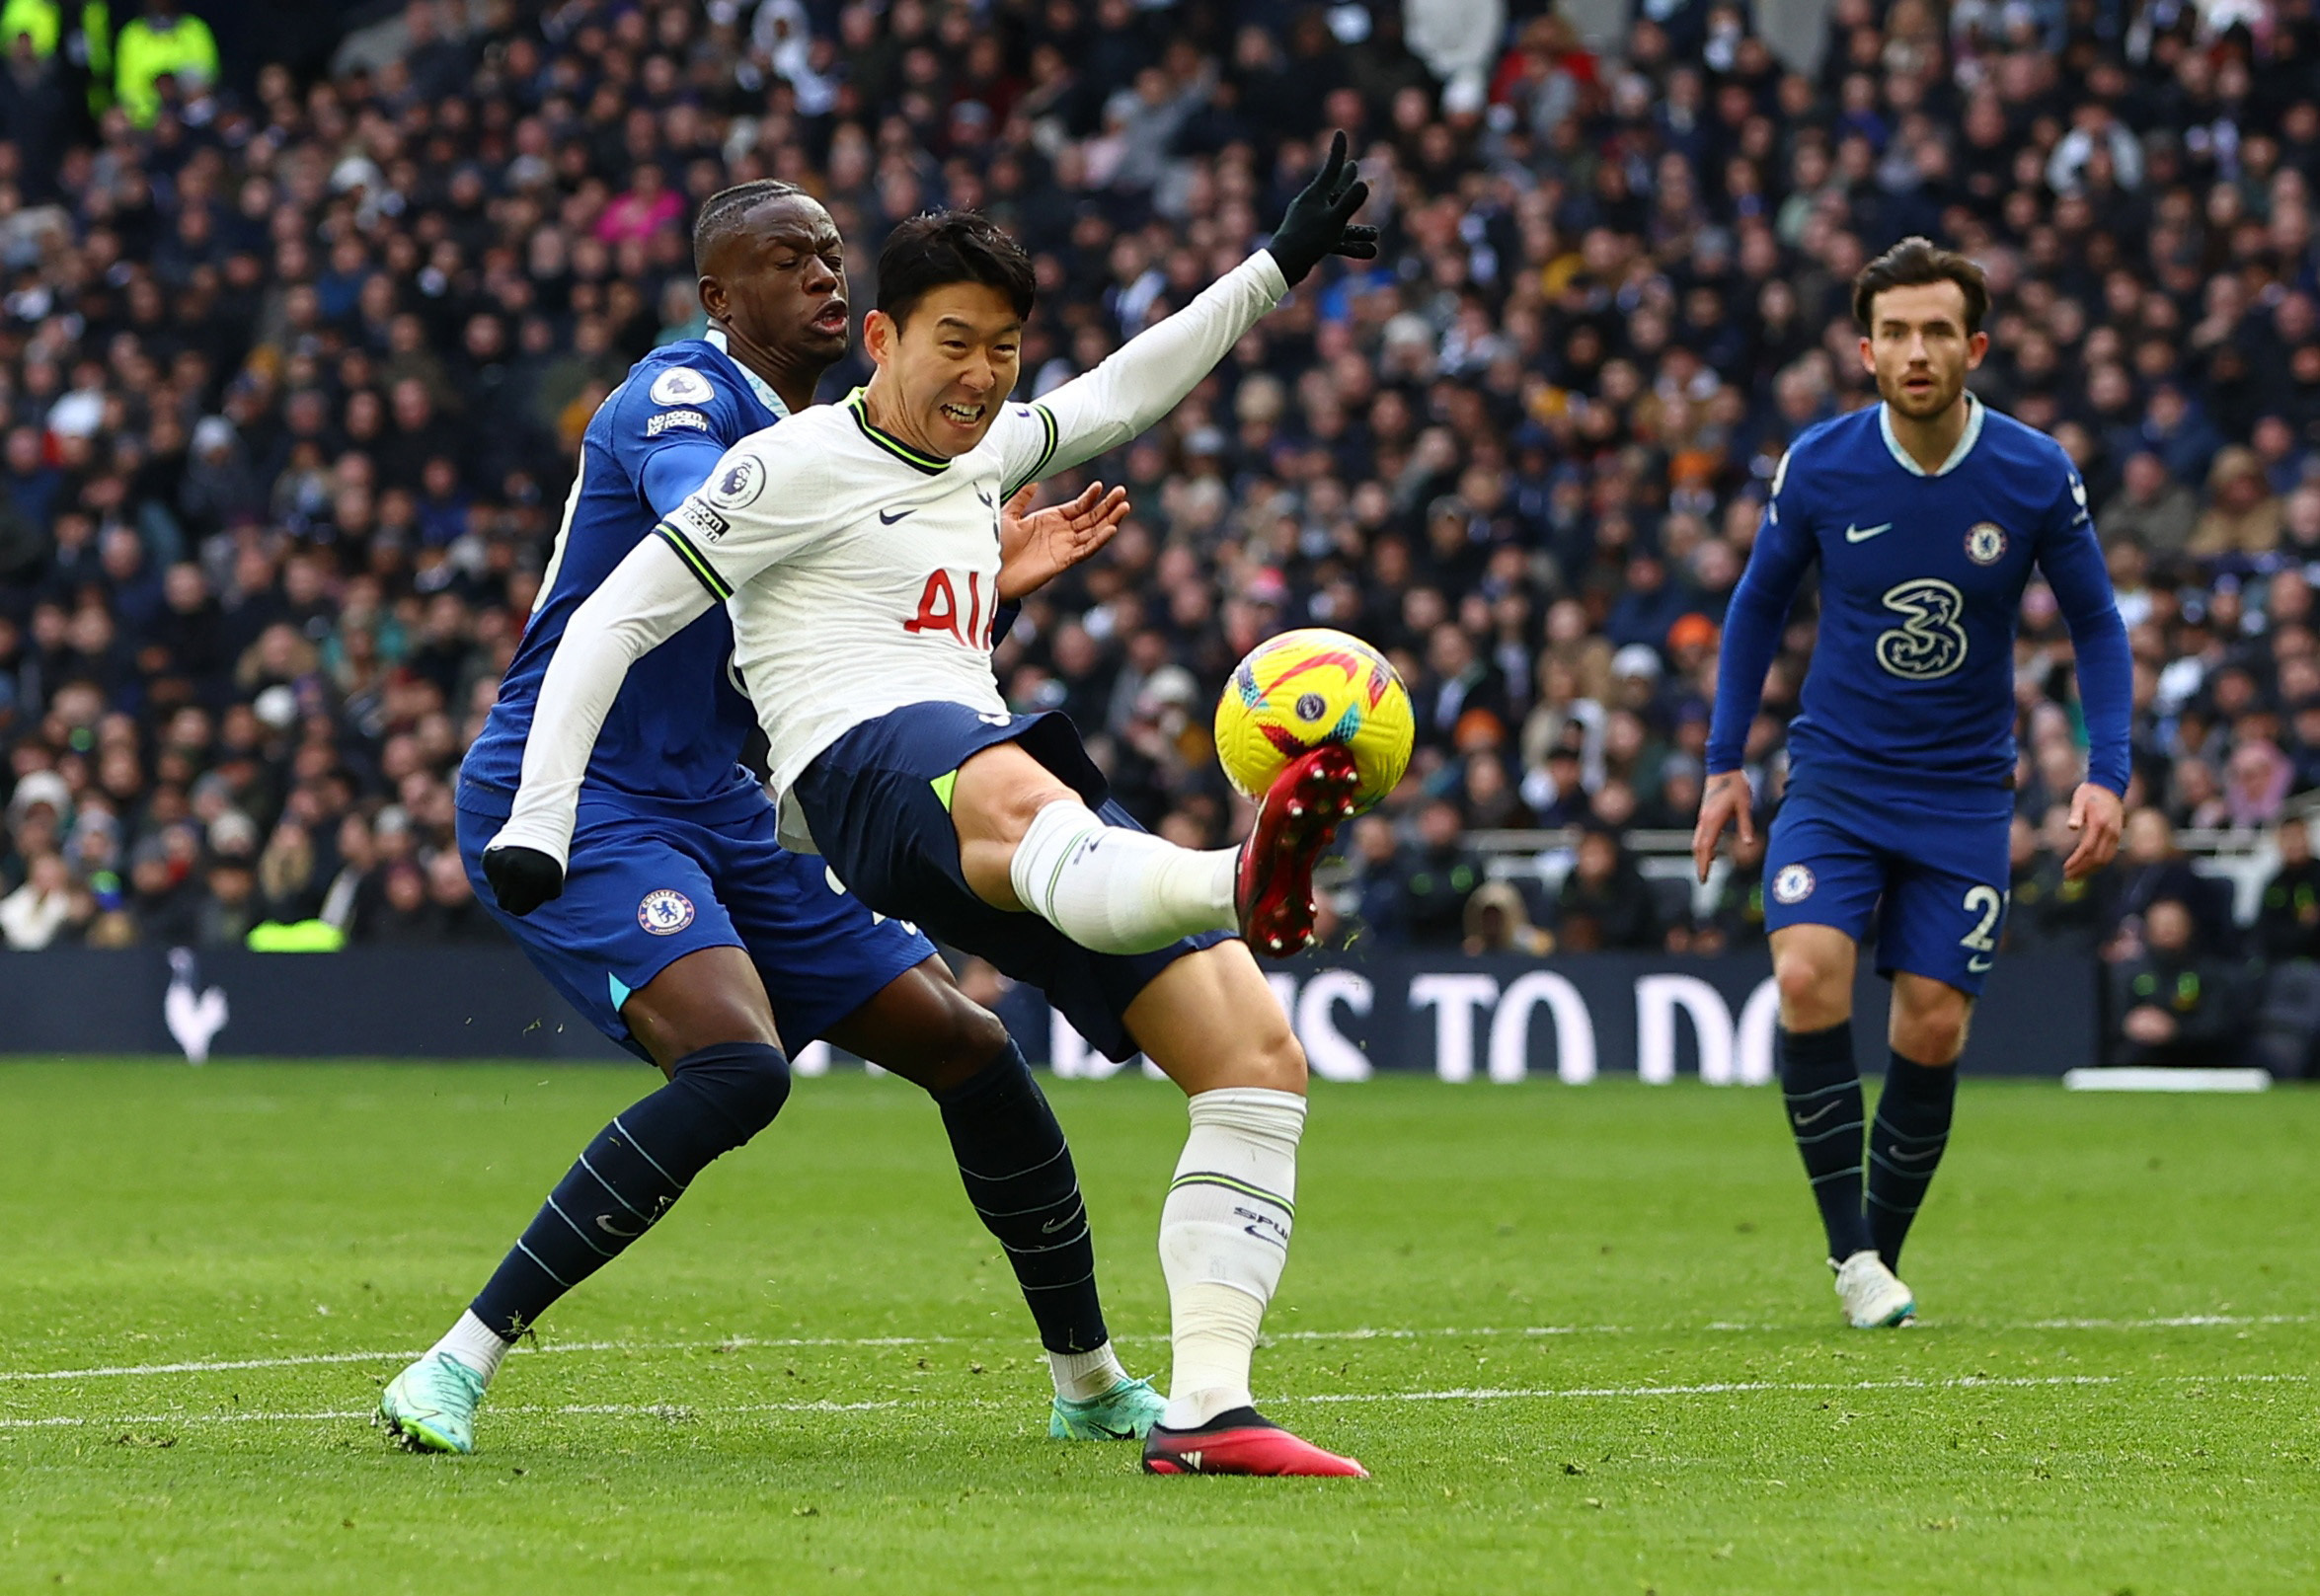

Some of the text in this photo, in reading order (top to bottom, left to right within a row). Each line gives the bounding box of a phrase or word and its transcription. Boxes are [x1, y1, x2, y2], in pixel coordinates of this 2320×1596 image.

[647, 418, 707, 436] for racism
[648, 411, 702, 427] No room
[694, 503, 724, 531] room
[903, 568, 998, 651] AI
[1876, 578, 1968, 680] 3
[1959, 884, 2011, 951] 2
[1408, 970, 1597, 1086] TO
